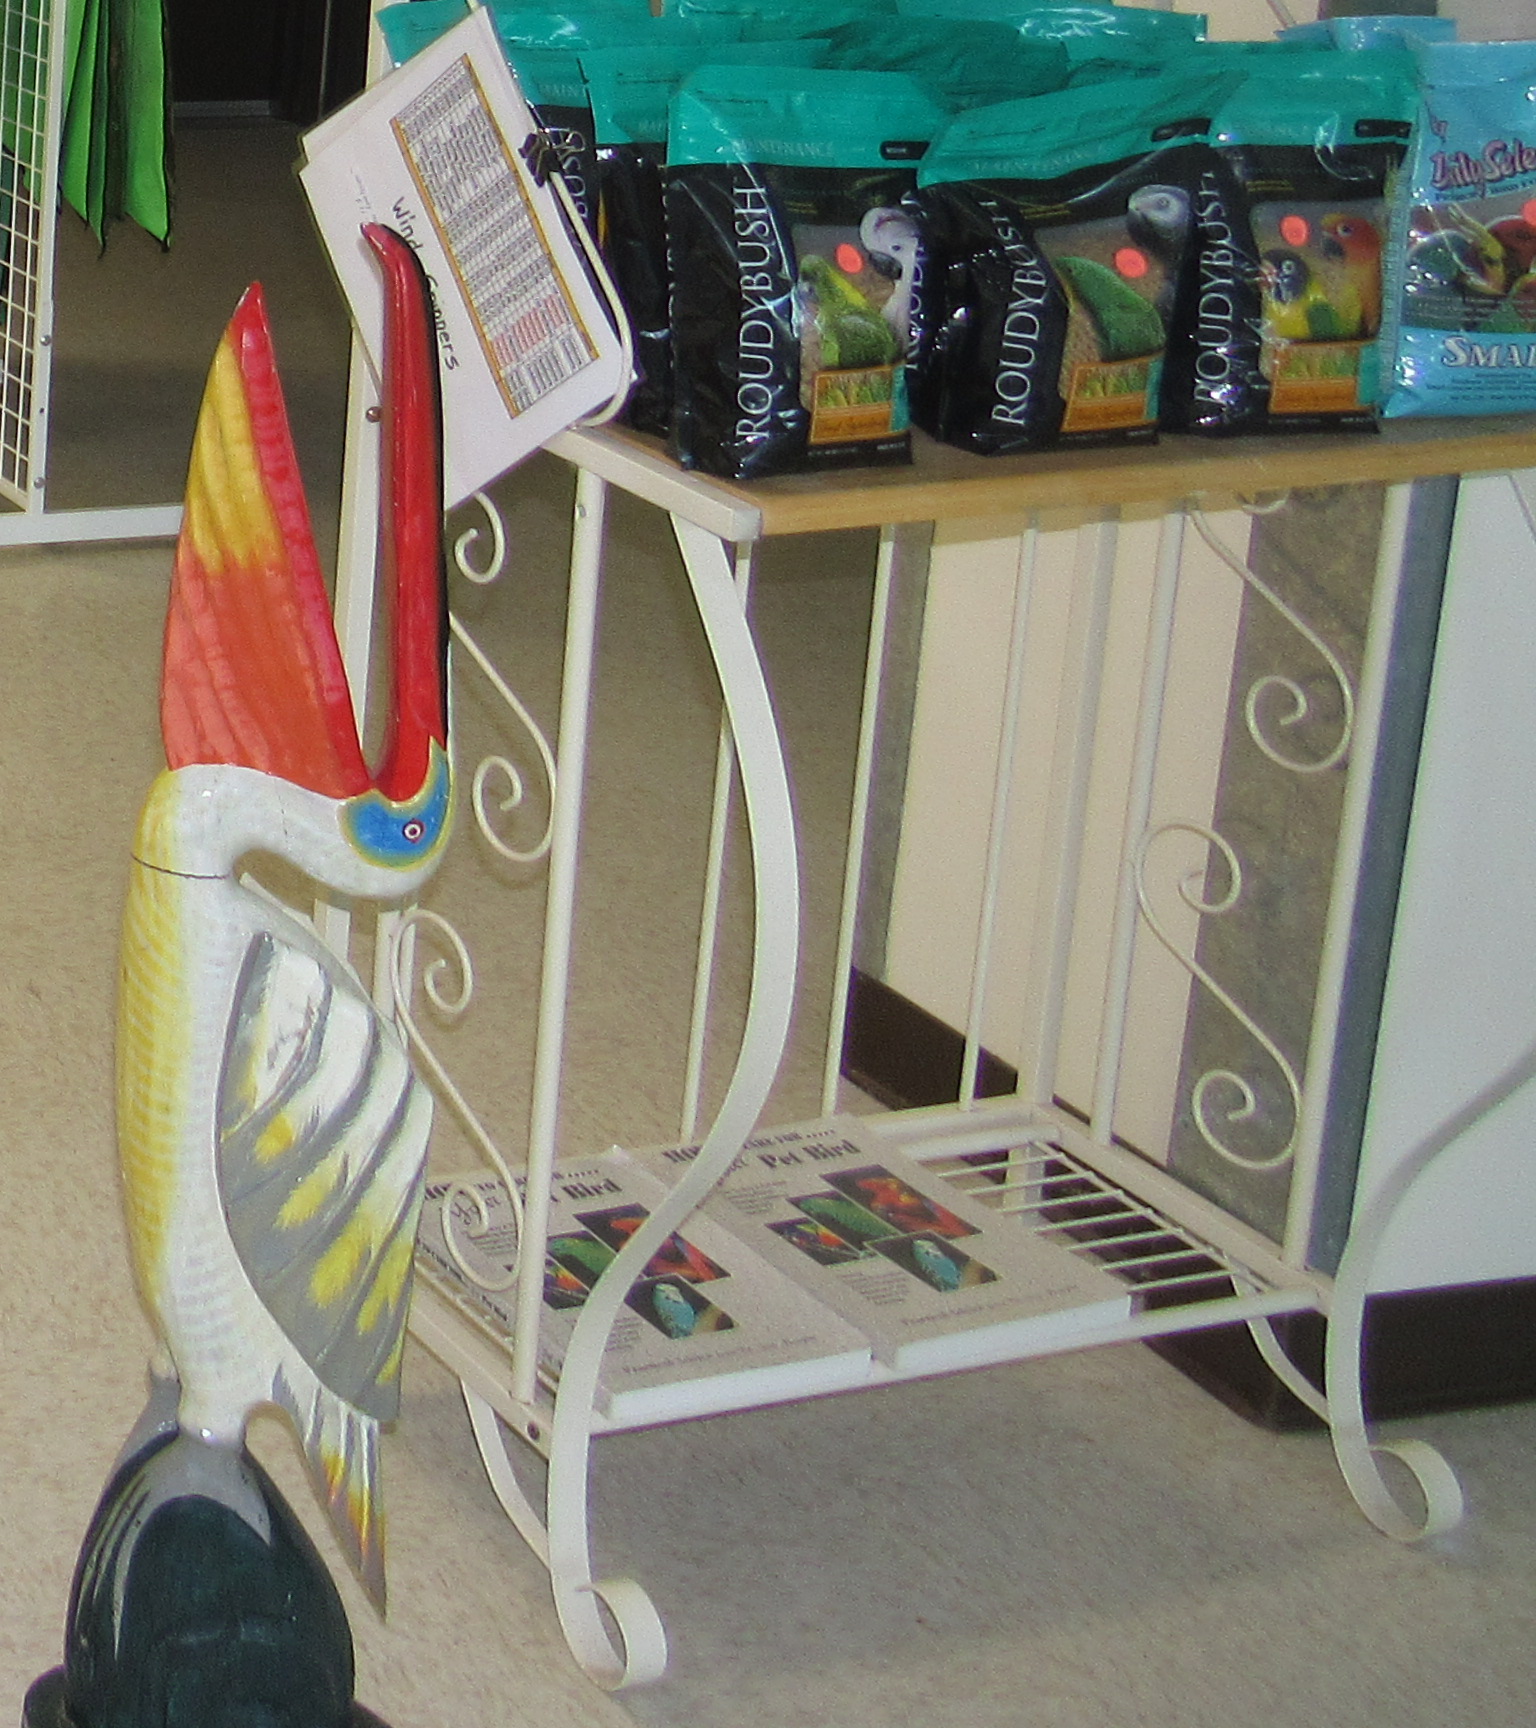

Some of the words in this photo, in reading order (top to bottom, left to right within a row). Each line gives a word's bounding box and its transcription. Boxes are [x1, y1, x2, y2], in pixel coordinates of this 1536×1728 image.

[732, 186, 775, 440] ROUDYBUSH
[757, 1151, 805, 1169] Pet
[802, 1138, 862, 1160] Bird
[561, 1177, 623, 1200] Bird
